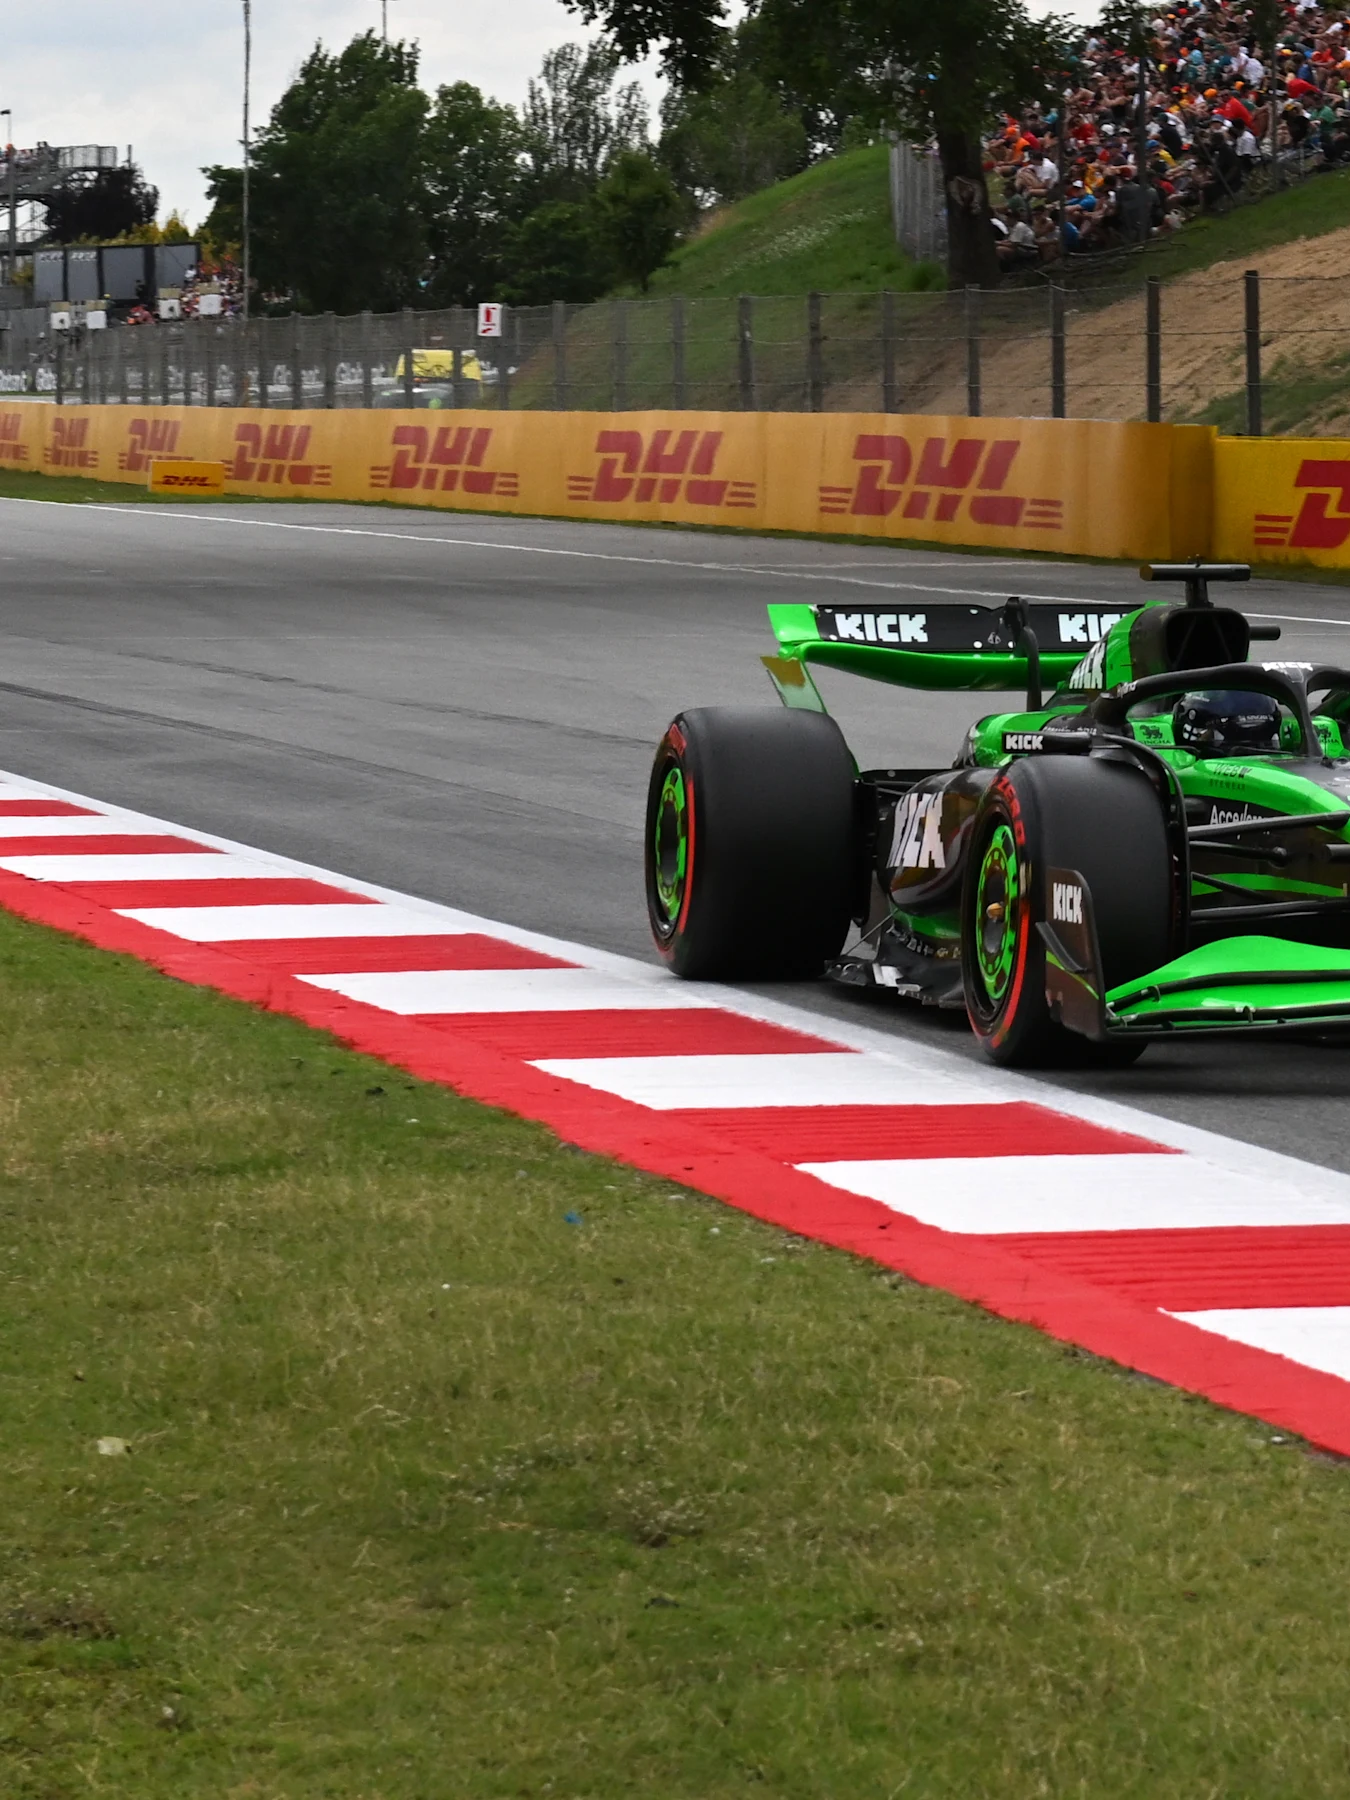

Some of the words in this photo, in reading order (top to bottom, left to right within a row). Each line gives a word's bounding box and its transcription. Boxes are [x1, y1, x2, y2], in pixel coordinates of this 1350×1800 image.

[233, 423, 314, 485] DHL
[389, 425, 497, 494] DHL
[591, 430, 731, 507] DHL
[160, 475, 210, 487] DHL
[850, 434, 1027, 527] DHL
[834, 613, 929, 642] KICK
[1057, 613, 1128, 643] KIC
[1261, 661, 1314, 672] KICK
[1005, 734, 1044, 751] KICK
[885, 790, 946, 869] KICK
[1052, 882, 1083, 925] KICK
